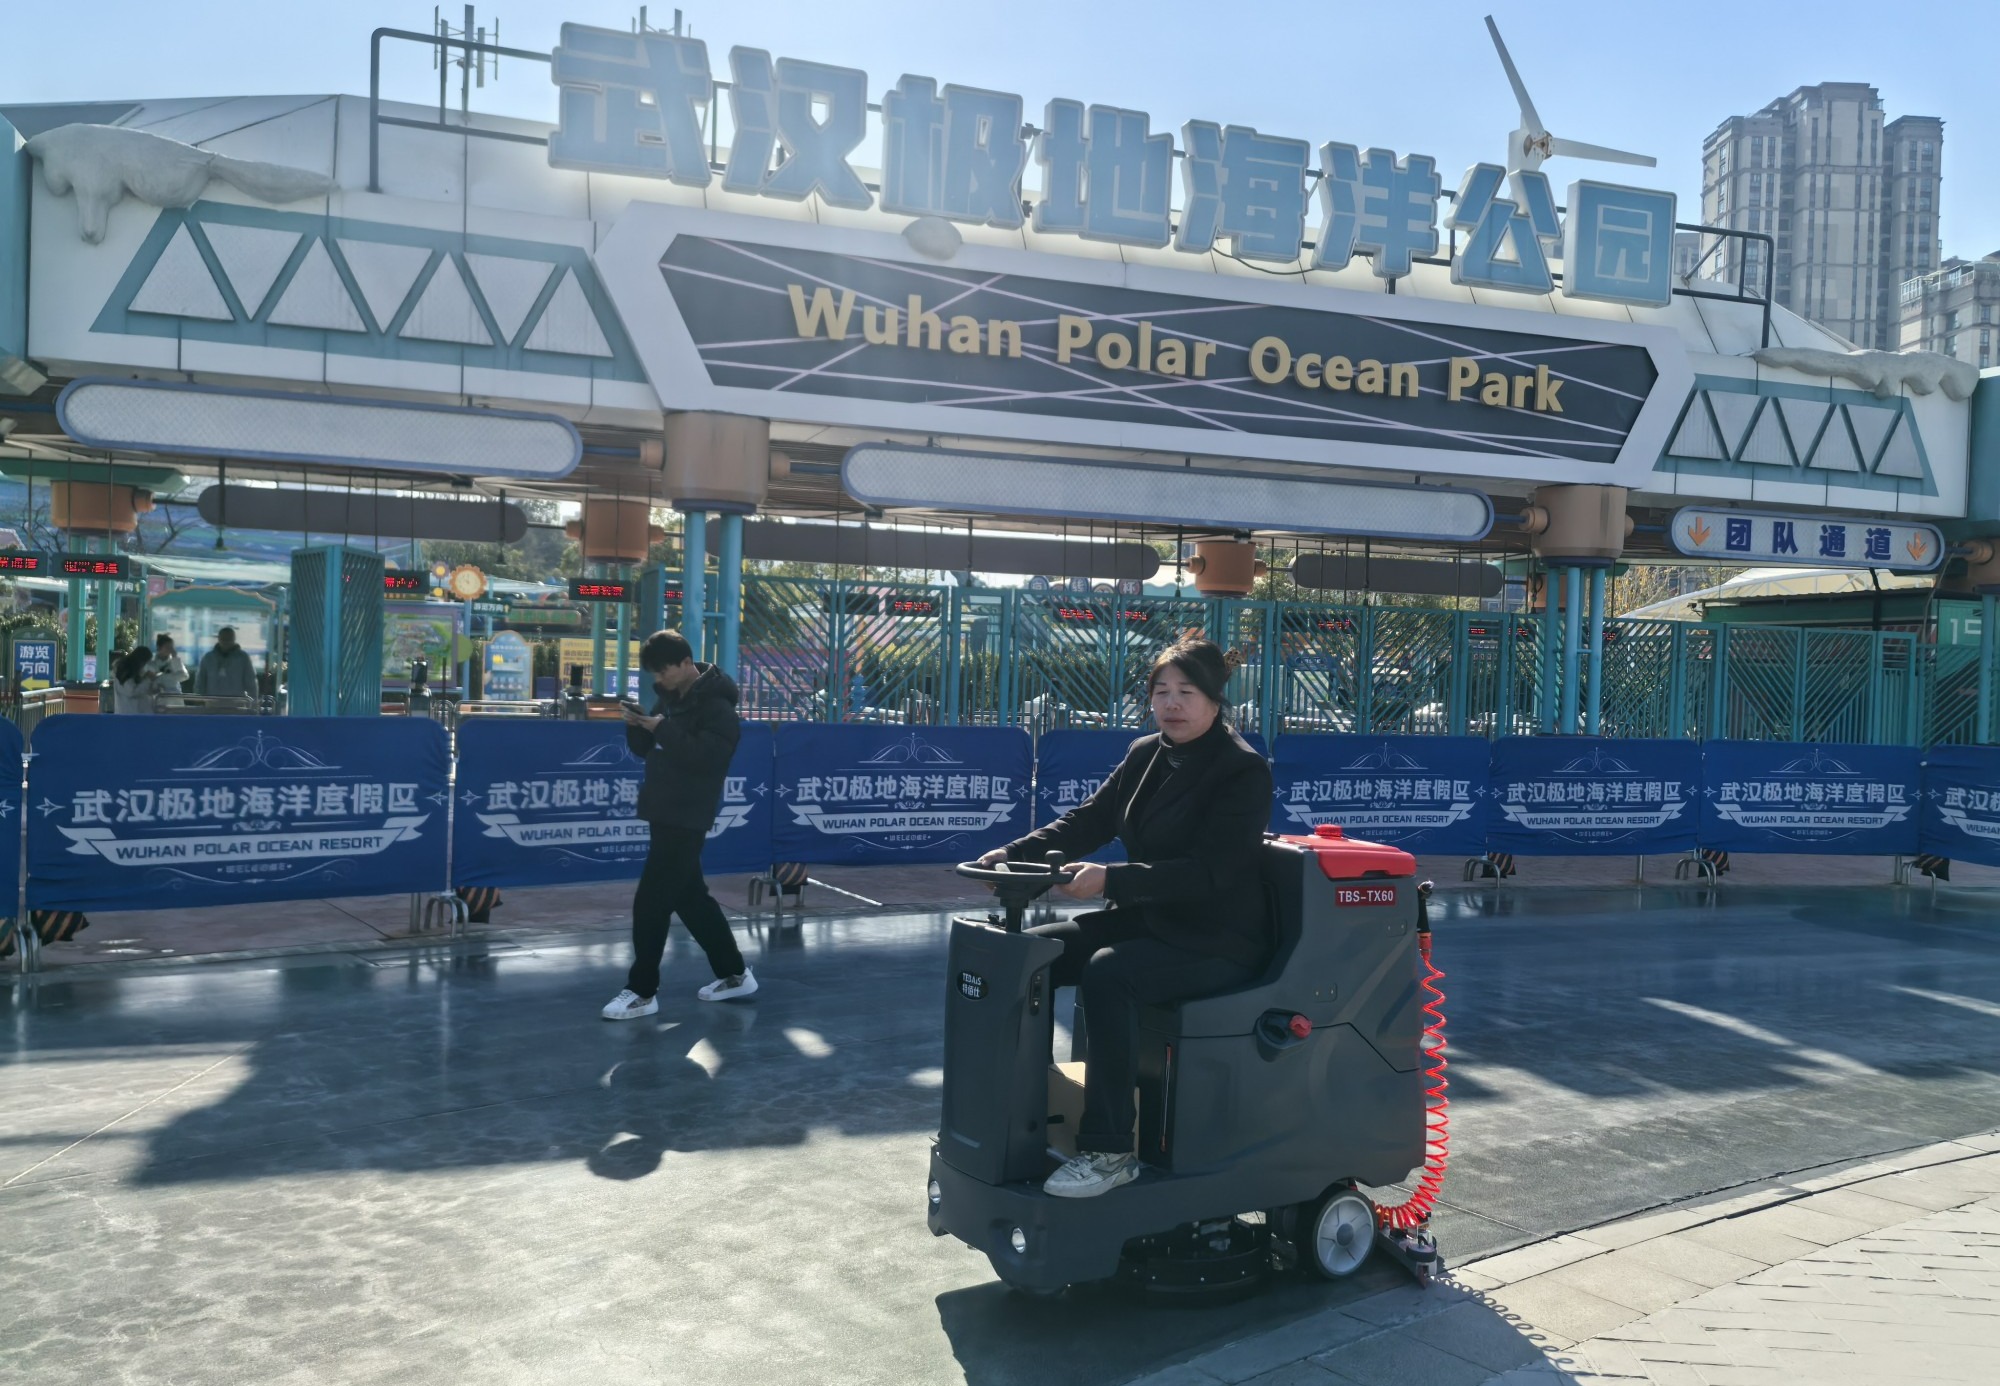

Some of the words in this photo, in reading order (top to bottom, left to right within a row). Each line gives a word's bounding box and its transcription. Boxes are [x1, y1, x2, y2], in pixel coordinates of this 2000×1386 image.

[548, 21, 1677, 307] 武汉极地海洋公园
[787, 283, 1022, 361] Wuhan
[1057, 313, 1217, 380] Polar
[1248, 335, 1421, 400] Ocean
[1448, 355, 1565, 415] Park
[1725, 517, 1892, 561] 团队通道
[20, 645, 49, 659] 游览
[20, 661, 49, 675] 方向
[486, 776, 747, 811] 武汉极地海区
[797, 774, 1011, 801] 武汉极地海洋度假区
[1290, 779, 1471, 802] 武汉极地海洋度假区
[1507, 781, 1682, 803] 武汉极地海洋度假区
[1720, 781, 1906, 804] 武汉极地海洋度假区
[72, 783, 420, 825] 武汉极地海洋度假区
[822, 818, 867, 830] WUHAN
[870, 817, 905, 828] POLAR
[909, 817, 944, 827] OCEAN
[948, 816, 988, 827] RESORT
[1311, 815, 1347, 827] WUHAN
[1350, 815, 1380, 825] POLAR
[1382, 814, 1412, 824] OCEAN
[1415, 814, 1449, 824] RESORT
[1527, 816, 1561, 826] WUHAN
[1563, 816, 1592, 825] POLAR
[1595, 816, 1624, 825] OCEAN
[1626, 816, 1660, 825] RESORT
[1741, 815, 1777, 824] WUHAN
[1780, 815, 1811, 824] POLAR
[1814, 816, 1844, 825] OCEAN
[1847, 816, 1884, 825] RESORT
[520, 828, 572, 842] WUHAN
[578, 825, 621, 838] POLAR
[626, 824, 650, 836] OCE
[117, 844, 187, 860] WUHAN
[194, 841, 251, 857] POLAR
[258, 839, 313, 854] OCEAN
[319, 835, 384, 851] RESORT
[1338, 889, 1394, 903] TBS-TX60
